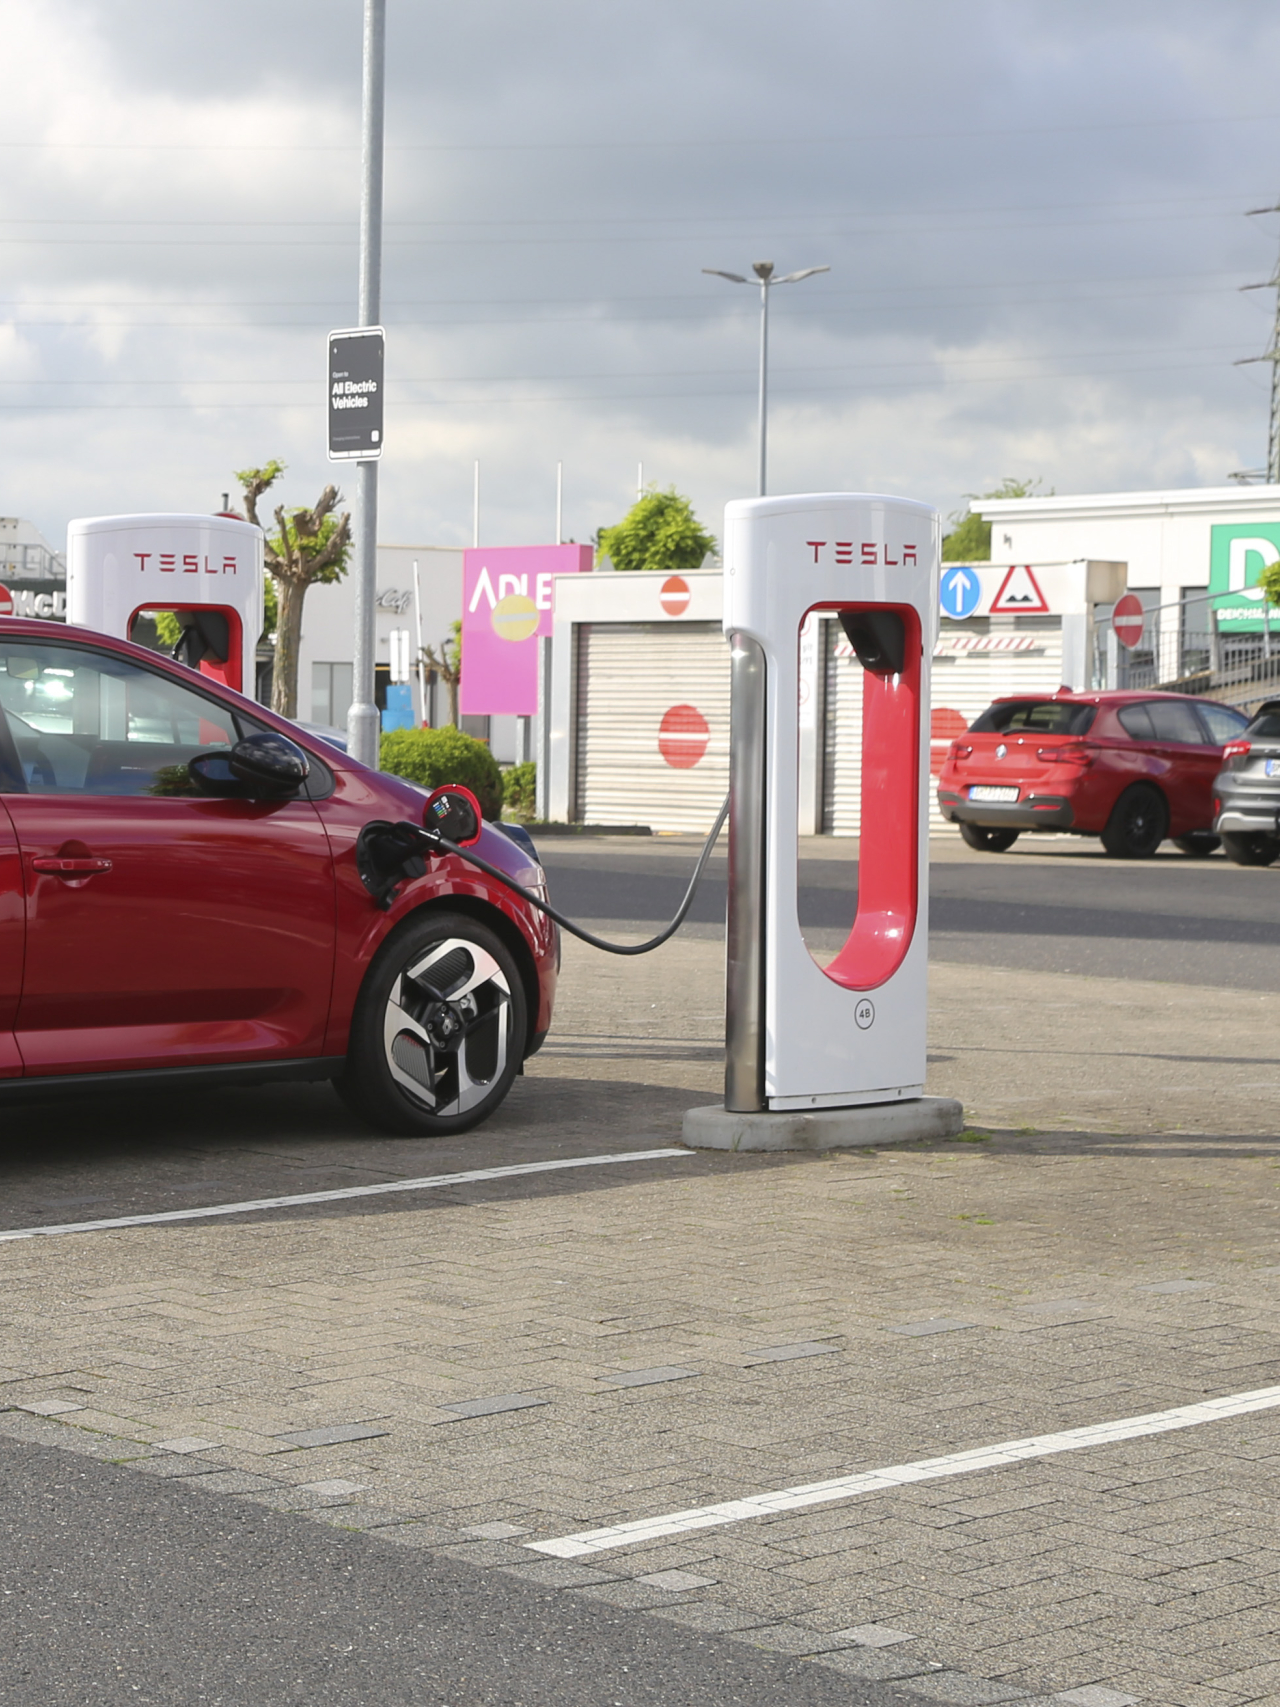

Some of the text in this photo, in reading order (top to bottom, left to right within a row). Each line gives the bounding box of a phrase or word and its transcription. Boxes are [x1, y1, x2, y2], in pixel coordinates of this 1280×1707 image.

[332, 380, 377, 395] All Electric
[332, 395, 368, 410] Vehicles
[805, 541, 917, 567] TESLA
[133, 553, 237, 575] TESLA
[859, 1008, 871, 1019] 4B
